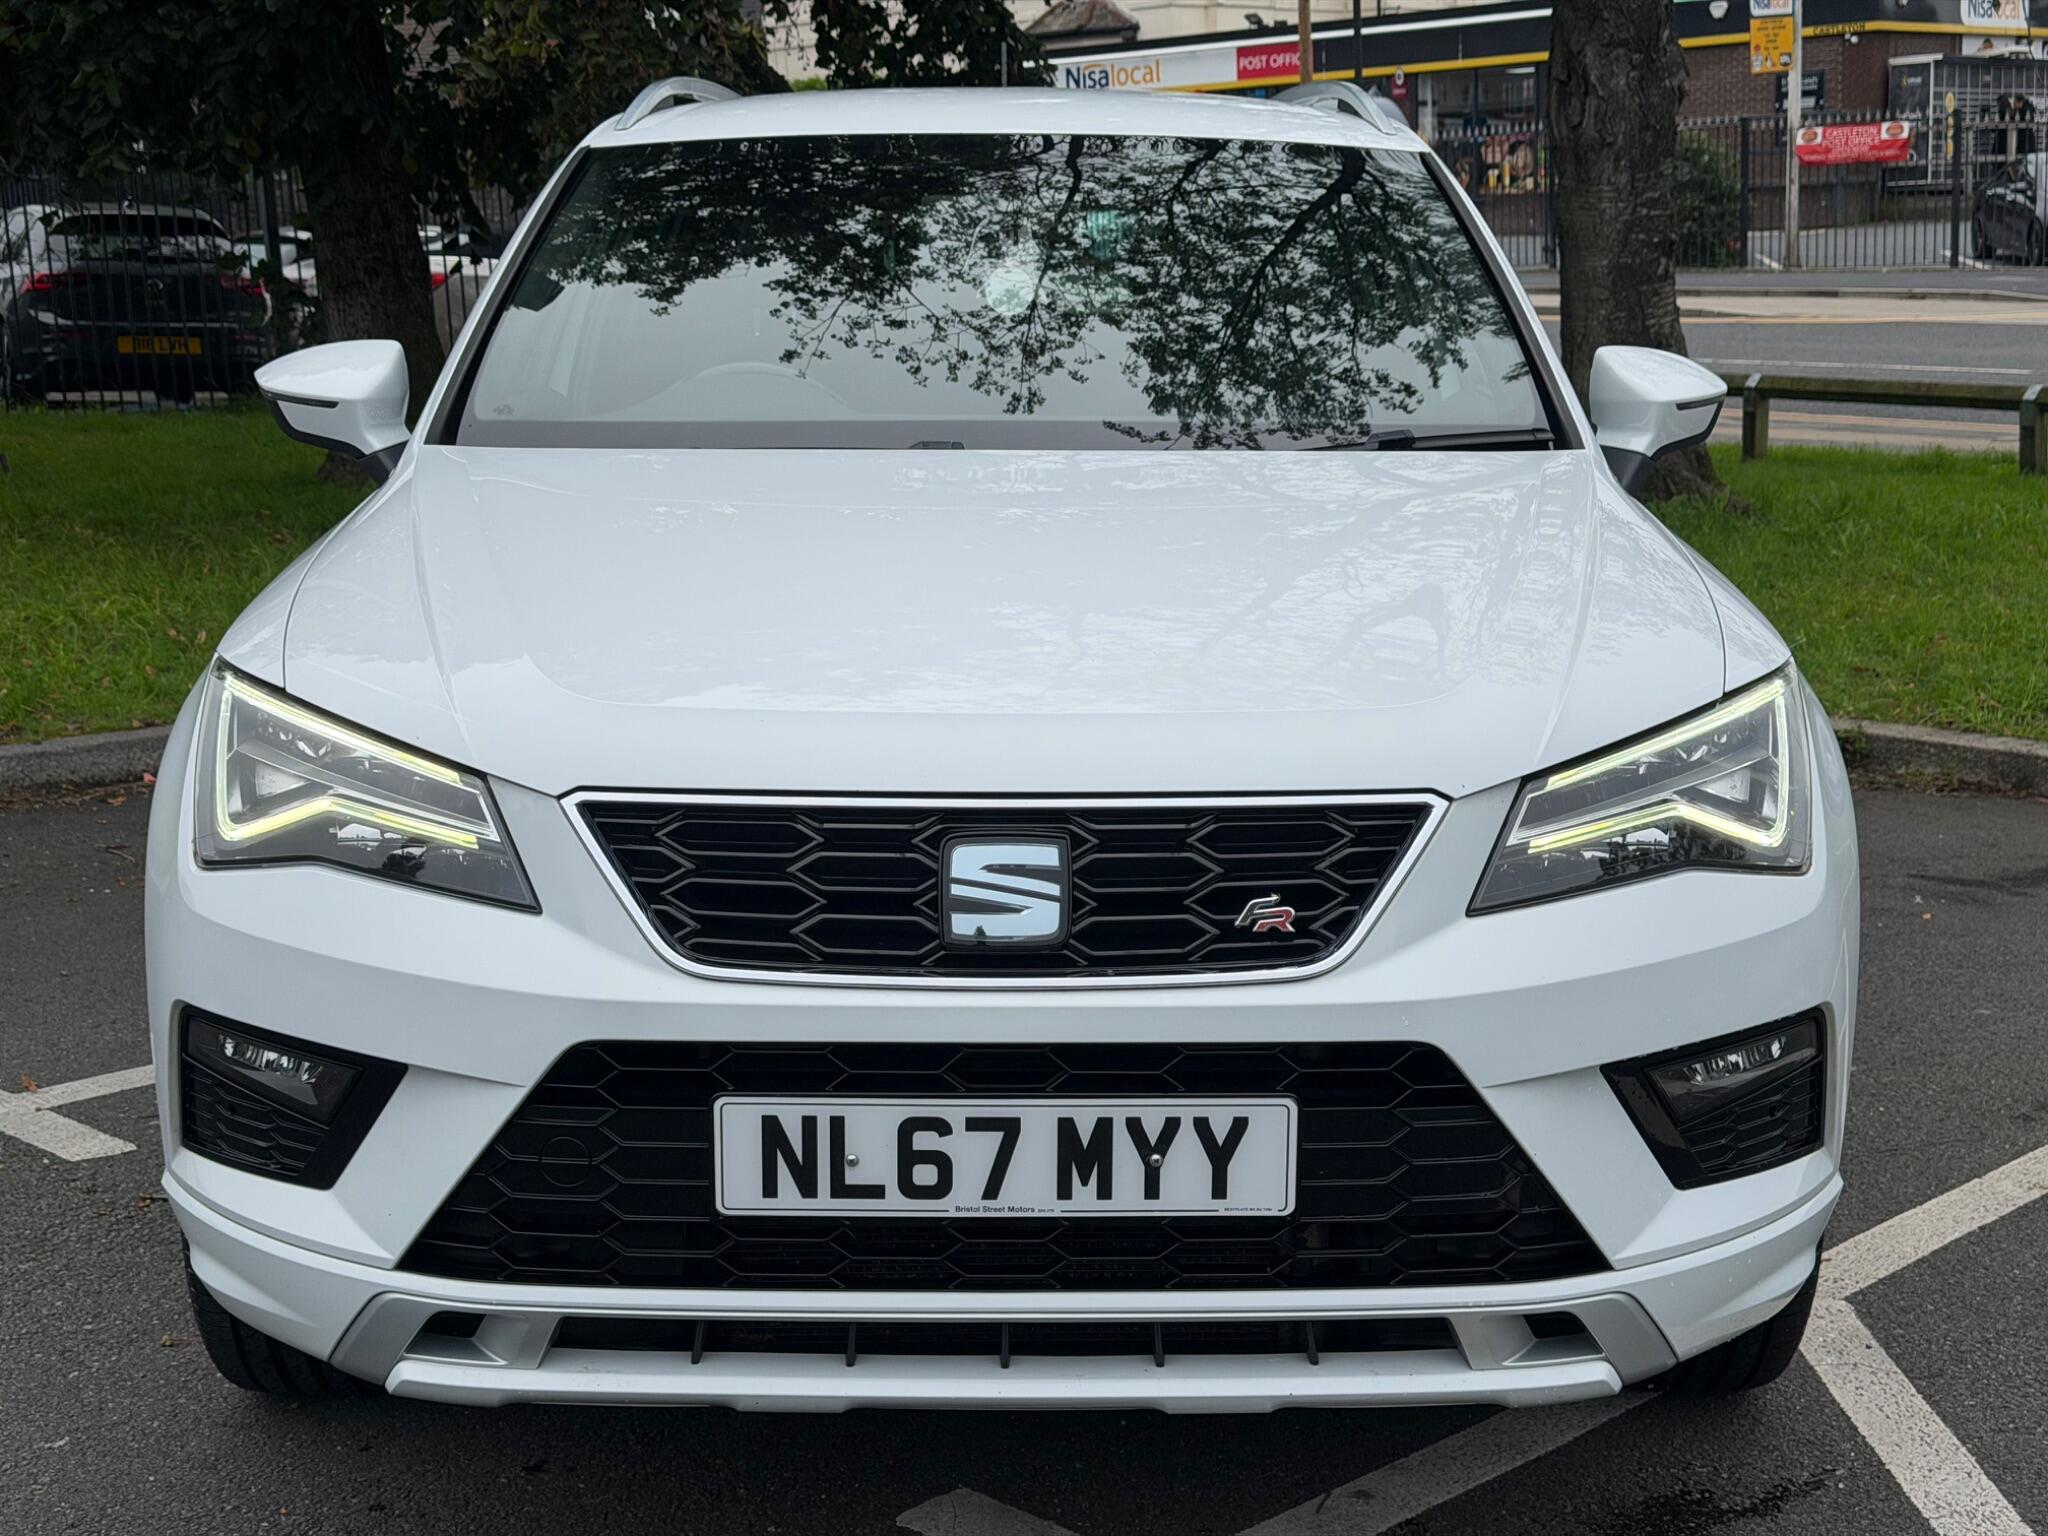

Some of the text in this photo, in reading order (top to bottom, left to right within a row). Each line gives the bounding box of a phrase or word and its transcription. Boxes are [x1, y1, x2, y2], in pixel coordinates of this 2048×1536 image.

[1239, 51, 1302, 71] POST OFFIC
[1825, 126, 1877, 139] CASTLETON
[1822, 135, 1880, 149] POST OFFICE
[1235, 893, 1296, 933] FR
[761, 1115, 1250, 1201] NL67 MYY
[955, 1205, 980, 1213] Bristol
[982, 1205, 1005, 1213] Street
[1007, 1205, 1035, 1213] Motors
